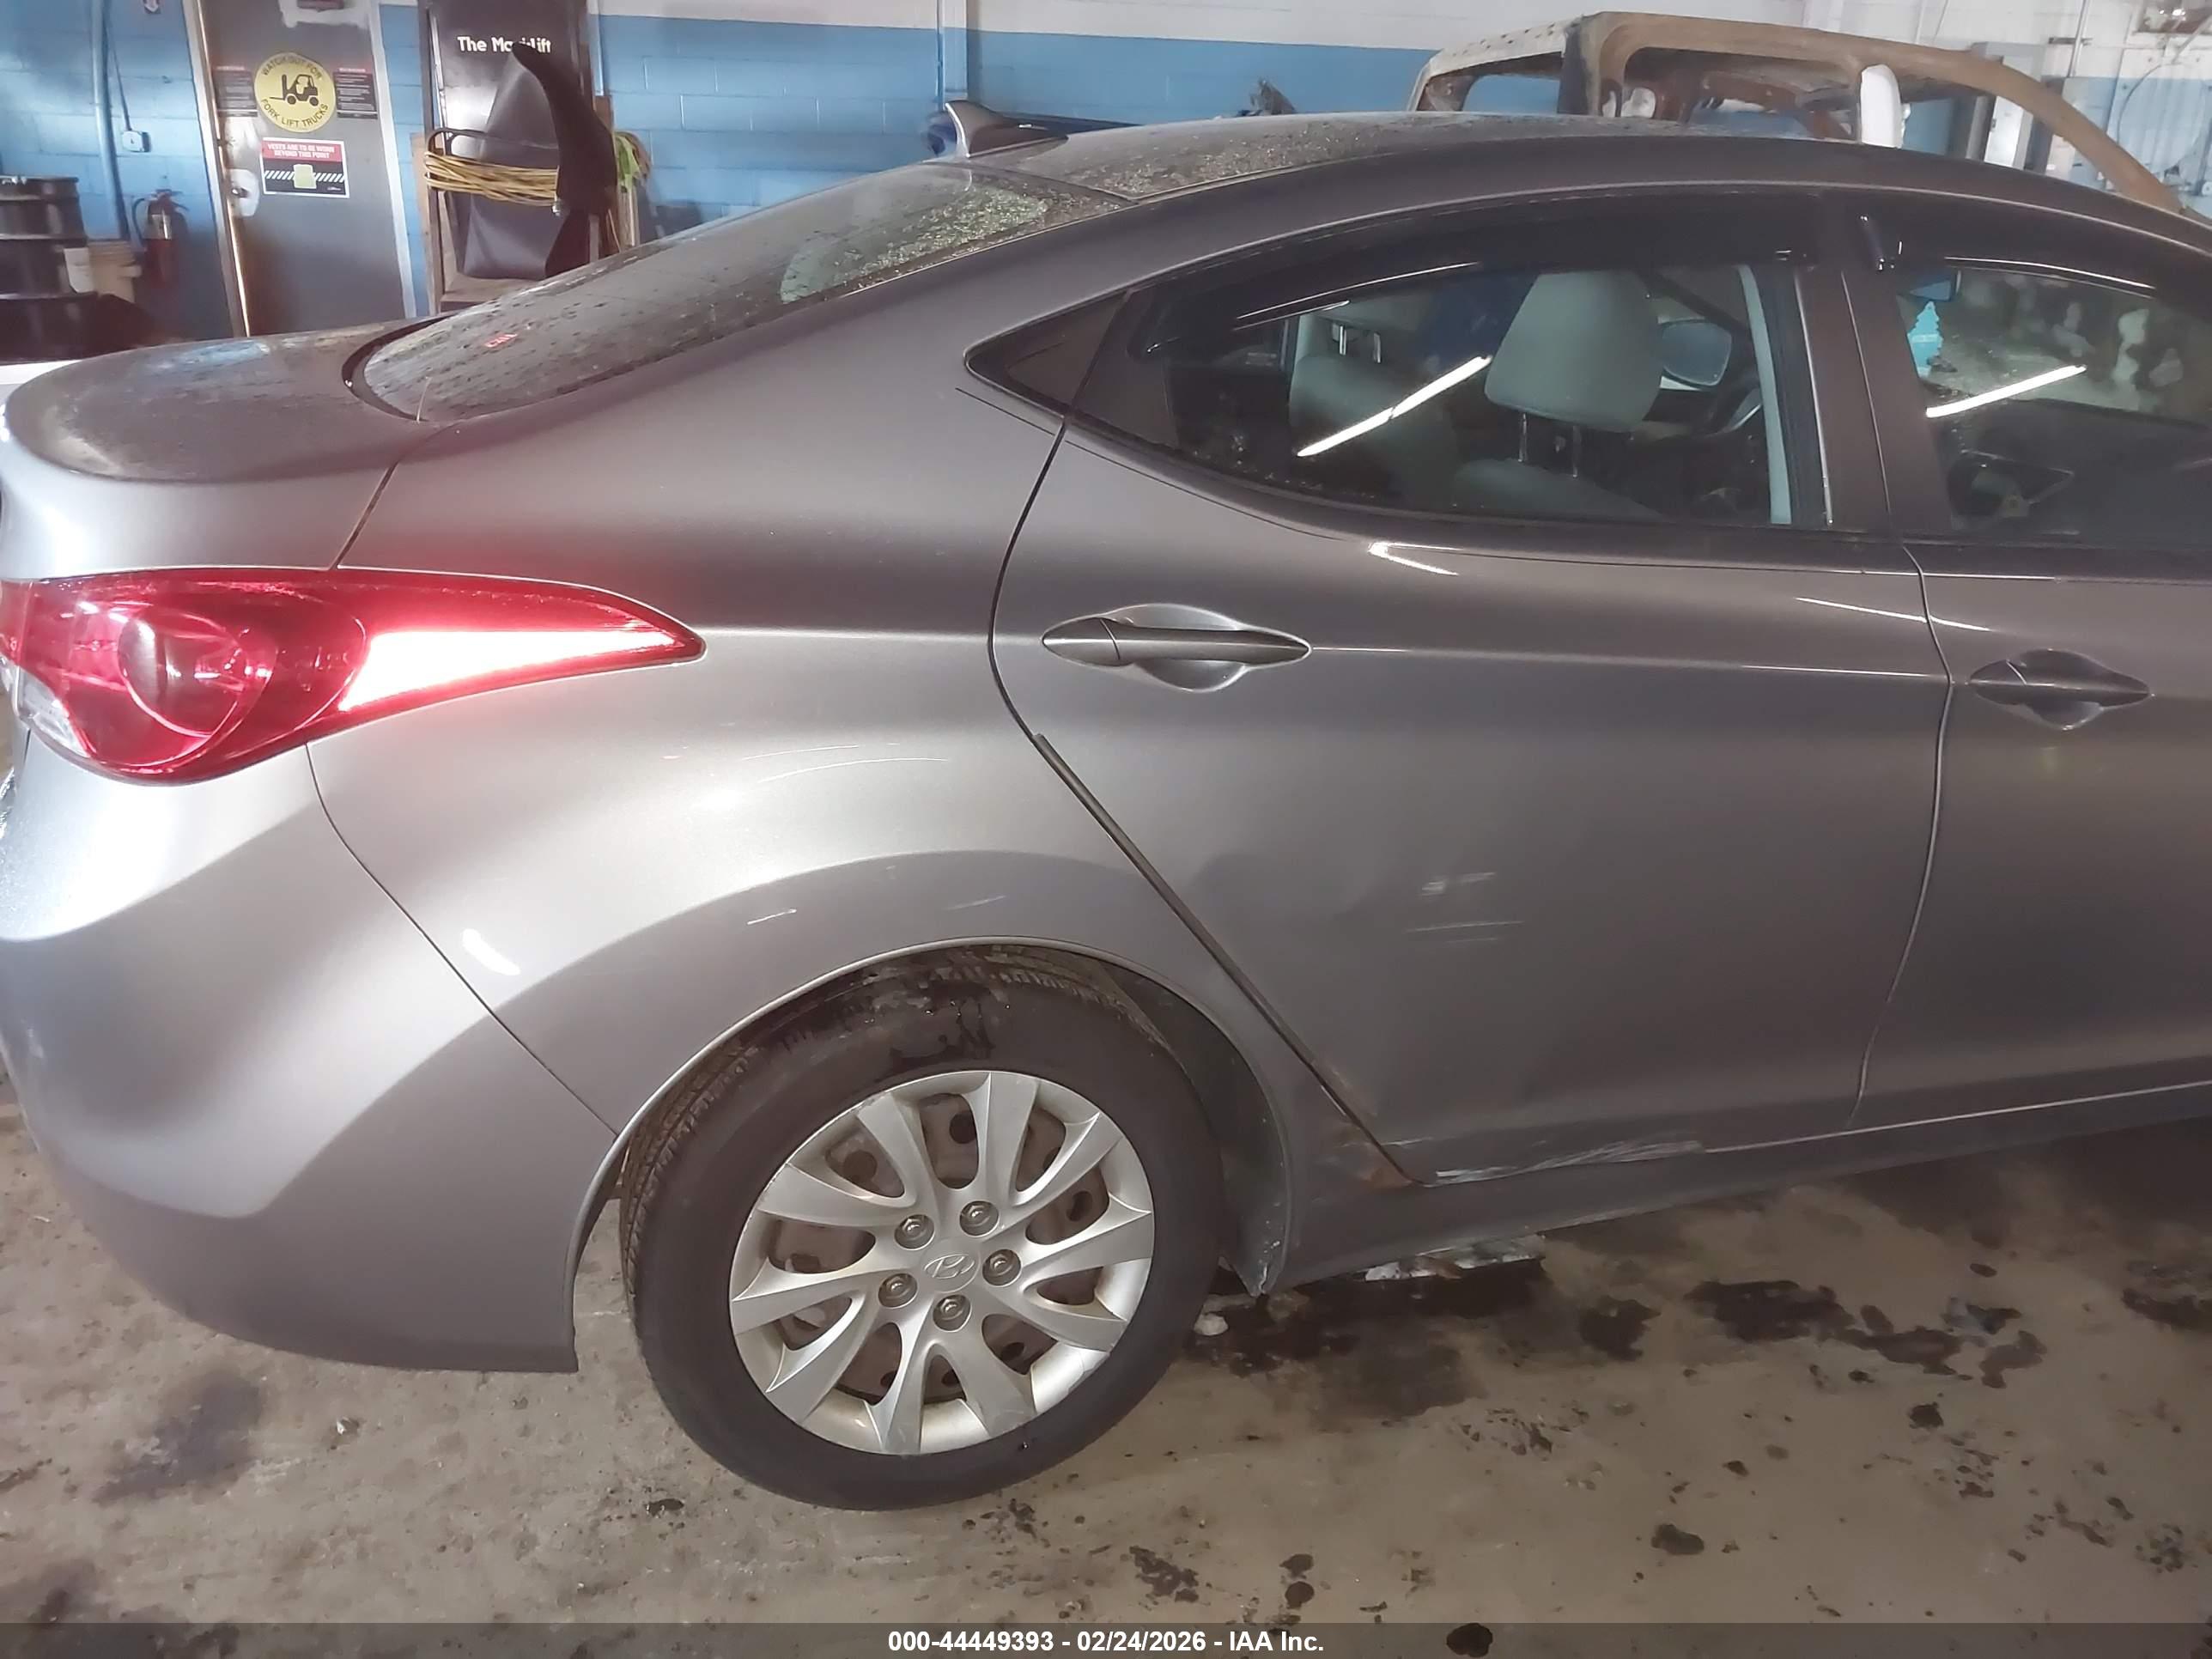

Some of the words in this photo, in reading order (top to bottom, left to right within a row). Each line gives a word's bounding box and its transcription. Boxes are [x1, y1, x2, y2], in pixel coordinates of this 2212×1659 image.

[457, 36, 488, 52] The
[306, 63, 324, 79] FOR
[261, 98, 280, 120] FORK
[281, 117, 300, 128] LIFT
[301, 103, 329, 127] TRUCKS
